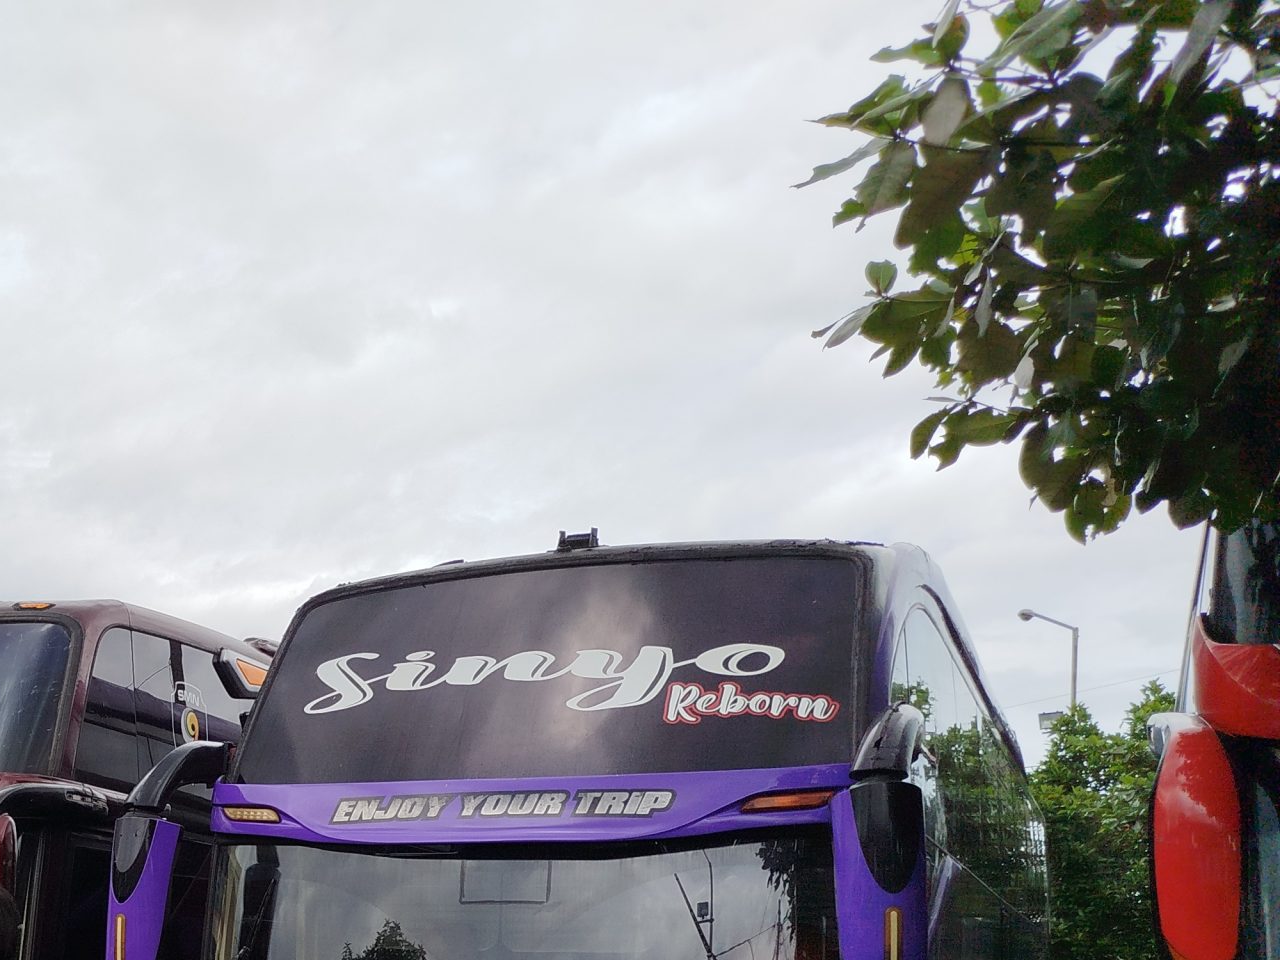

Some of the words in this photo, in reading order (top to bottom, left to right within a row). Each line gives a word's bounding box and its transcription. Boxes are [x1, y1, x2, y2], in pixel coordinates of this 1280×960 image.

[303, 644, 786, 715] Sinyo
[663, 681, 839, 724] Reborn
[331, 796, 451, 823] ENJOY
[458, 792, 568, 818] YOUR
[572, 790, 673, 816] TRIP
